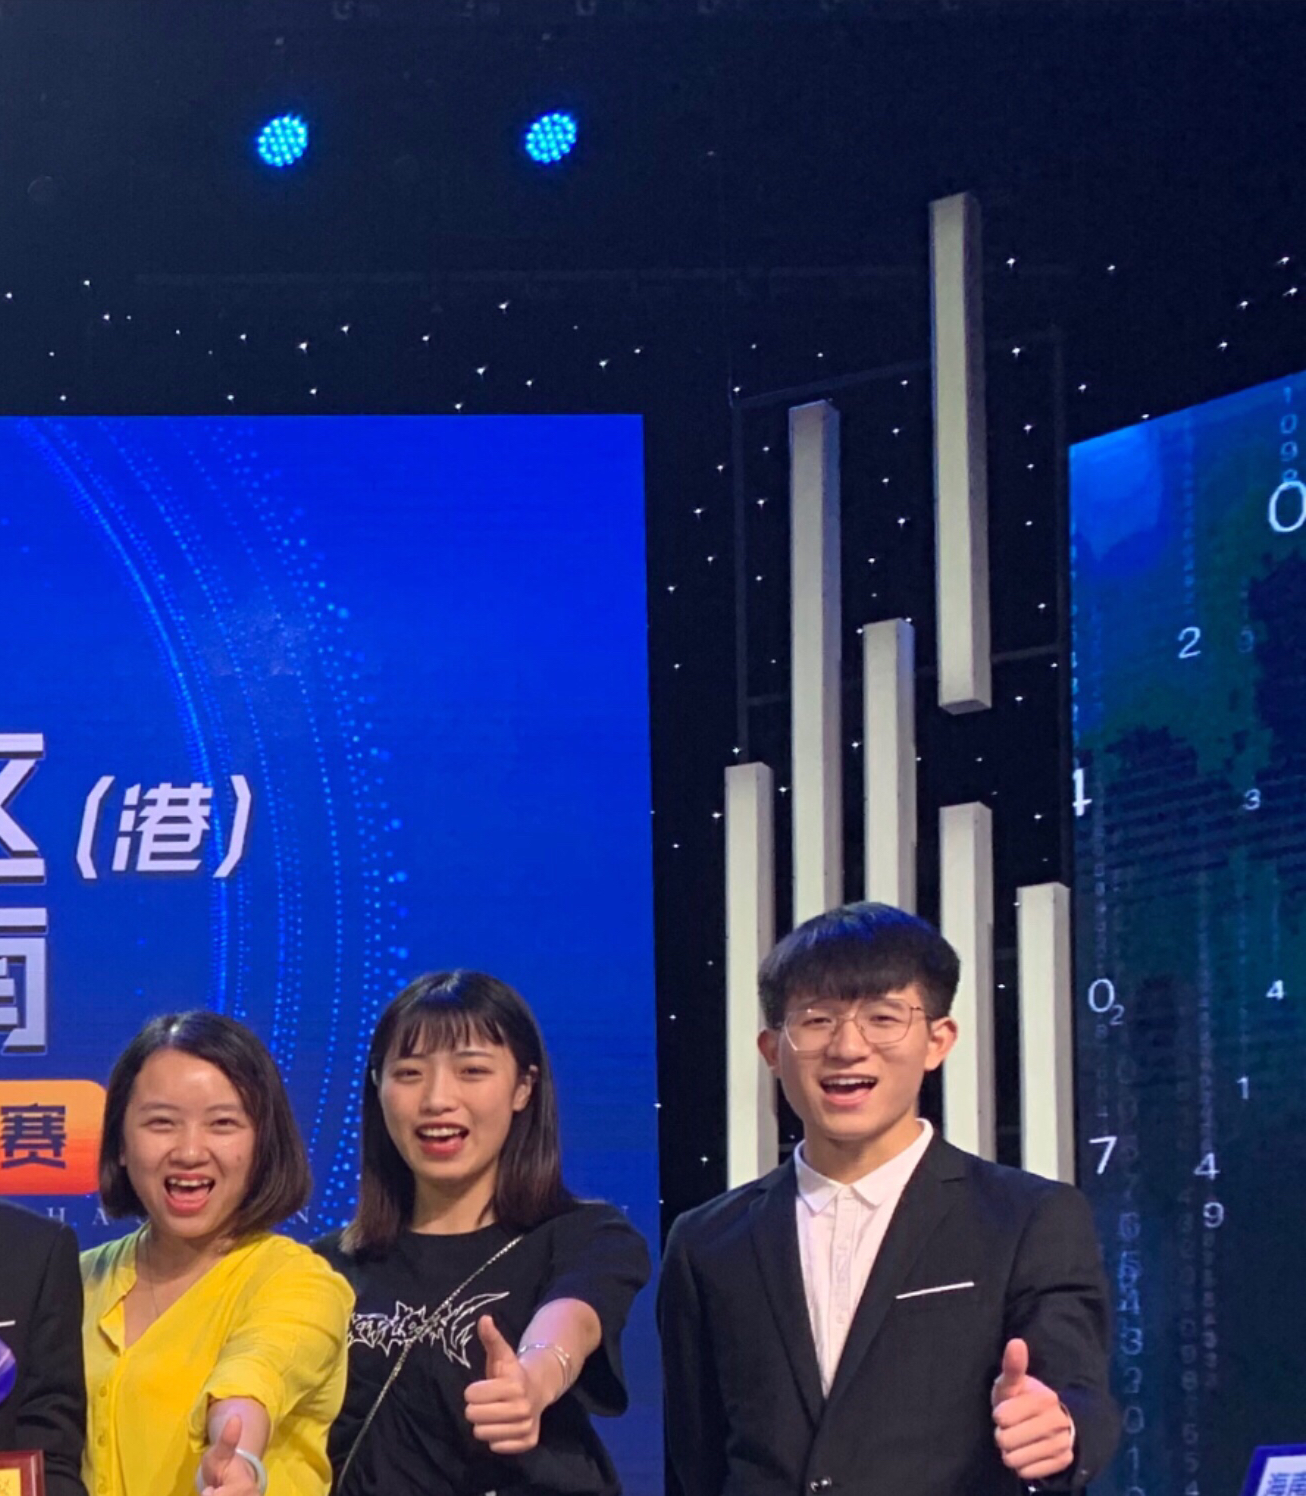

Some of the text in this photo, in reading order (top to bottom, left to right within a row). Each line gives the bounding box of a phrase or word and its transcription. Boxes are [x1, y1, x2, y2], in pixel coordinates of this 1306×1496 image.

[1178, 627, 1201, 658] 2
[1089, 978, 1115, 1013] 0
[1266, 980, 1285, 1000] 4
[1089, 1136, 1117, 1175] 7
[1195, 1152, 1220, 1180] 4
[1203, 1202, 1225, 1228] 9
